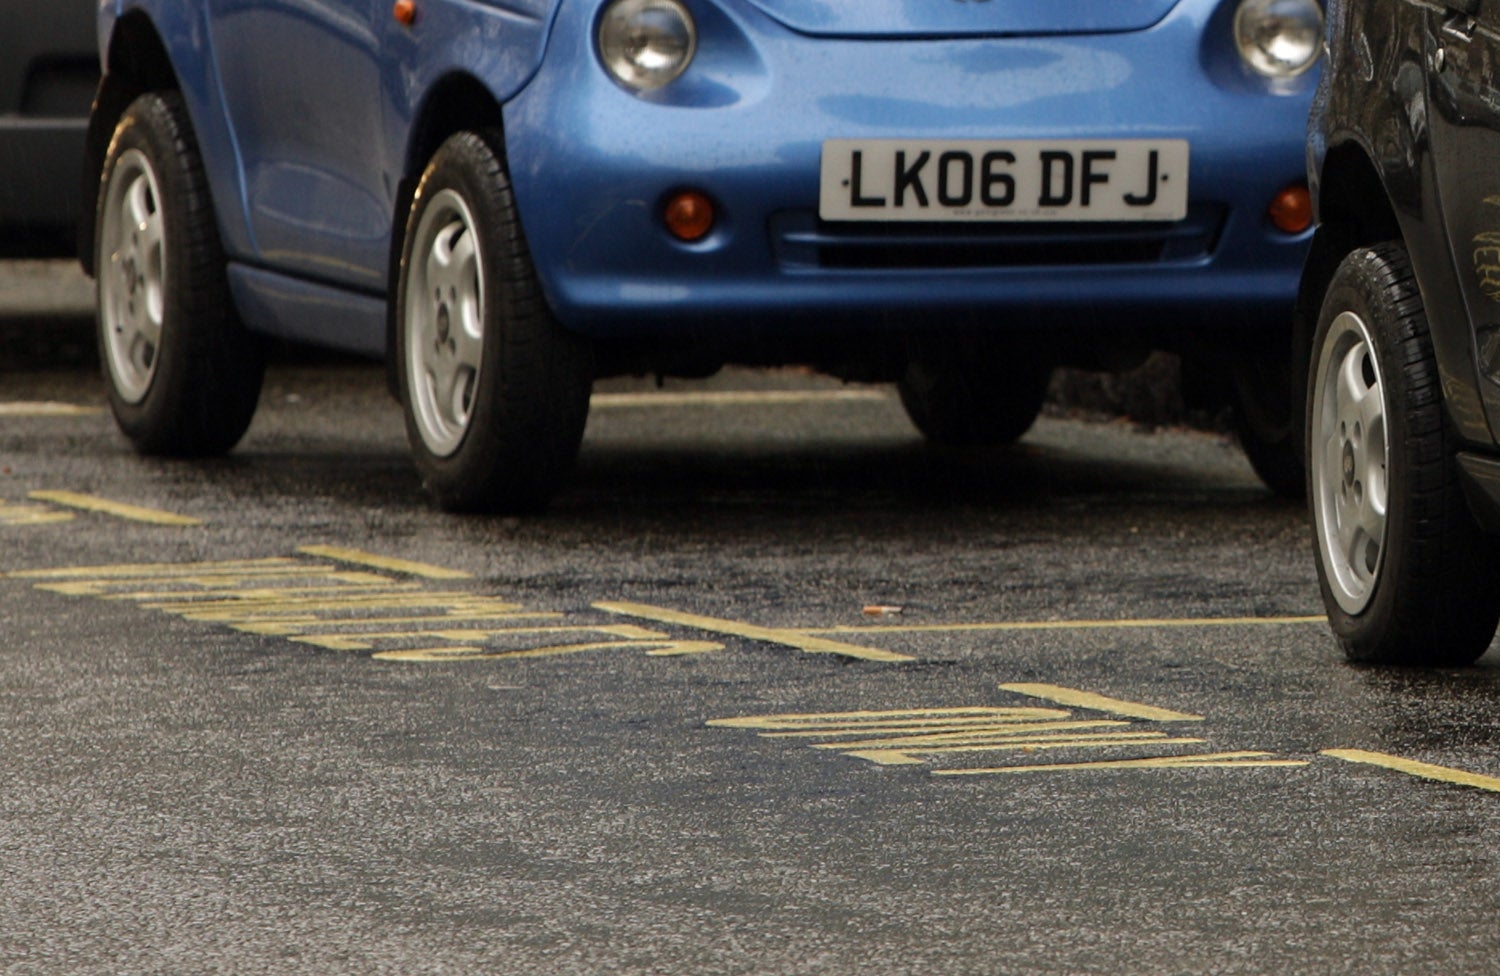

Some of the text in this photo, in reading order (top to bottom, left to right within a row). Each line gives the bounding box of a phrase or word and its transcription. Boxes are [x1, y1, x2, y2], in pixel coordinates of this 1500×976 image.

[850, 149, 1159, 208] LK06 DFJ
[705, 706, 1311, 776] ONLY
